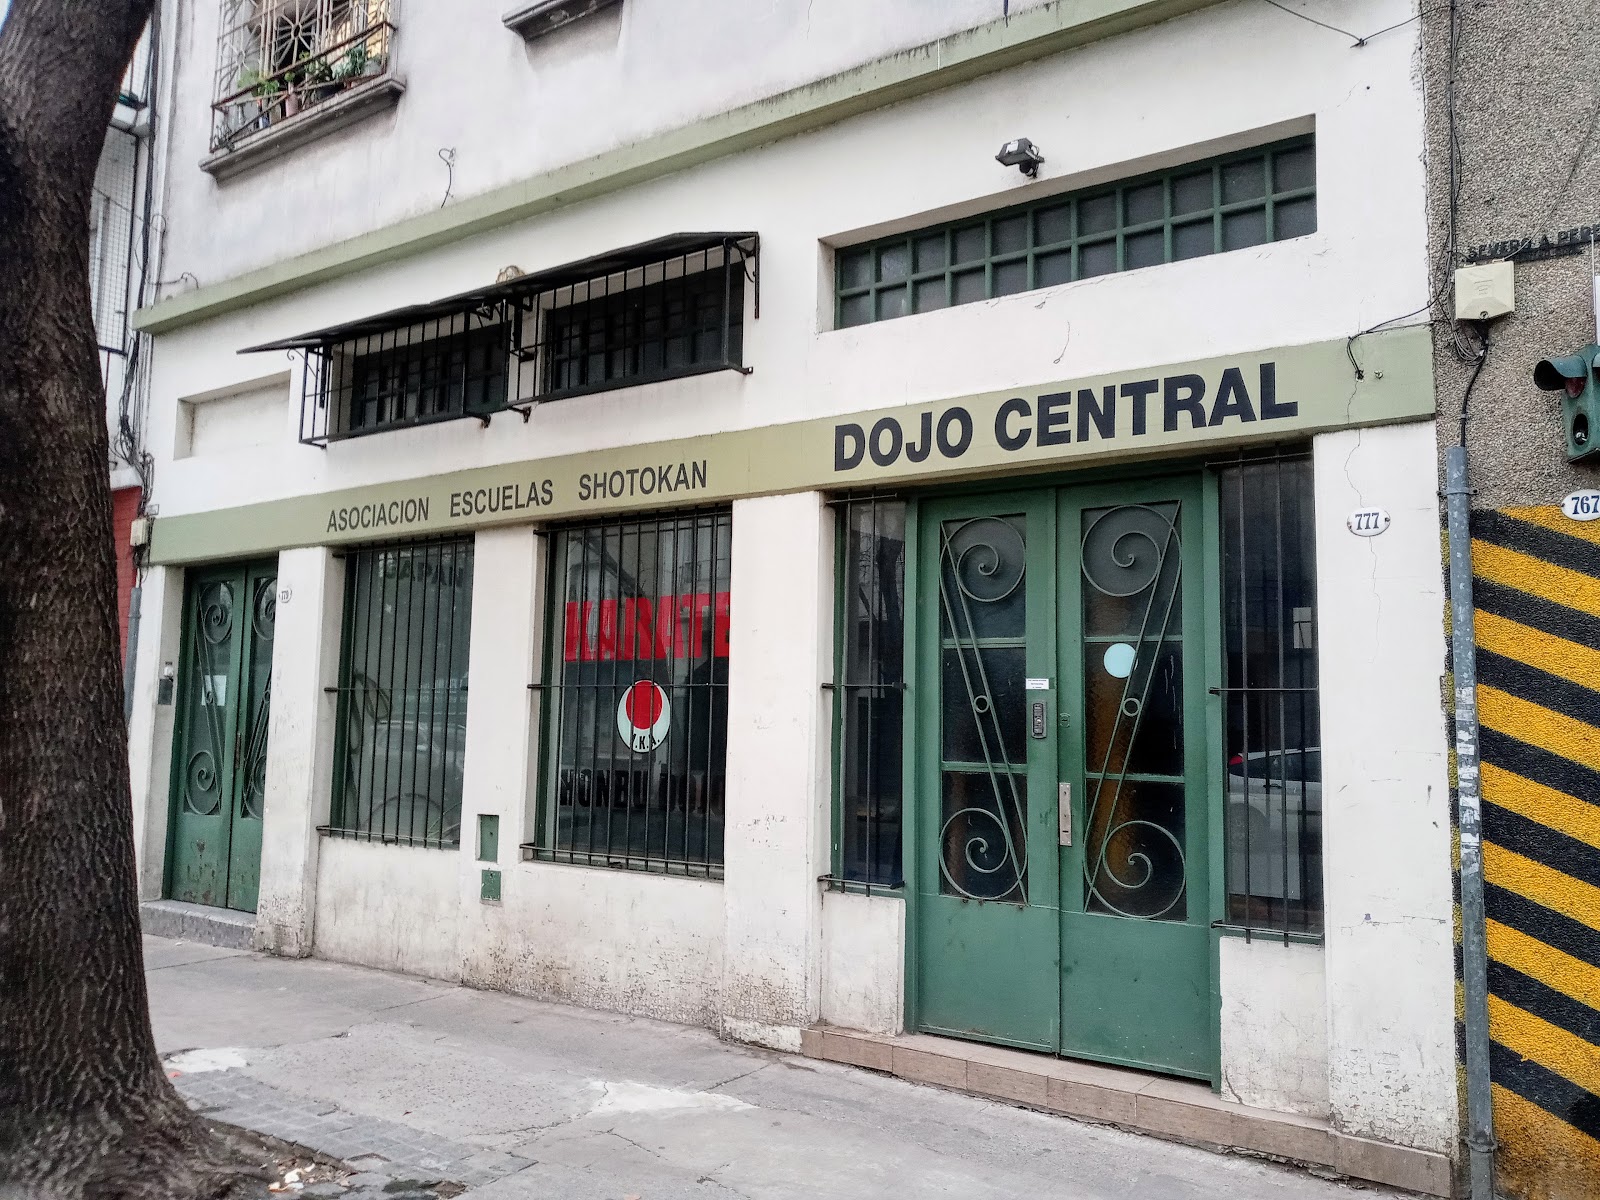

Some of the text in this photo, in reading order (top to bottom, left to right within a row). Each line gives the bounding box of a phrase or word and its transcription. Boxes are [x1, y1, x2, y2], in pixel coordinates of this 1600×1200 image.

[834, 361, 1299, 472] DOJO CENTRAL
[326, 459, 708, 533] ASOCIACION ESCUELAS SHOTOKAN
[1354, 511, 1380, 531] 777
[1571, 494, 1600, 515] 767
[565, 592, 730, 662] KARATE
[559, 768, 649, 809] HONBU
